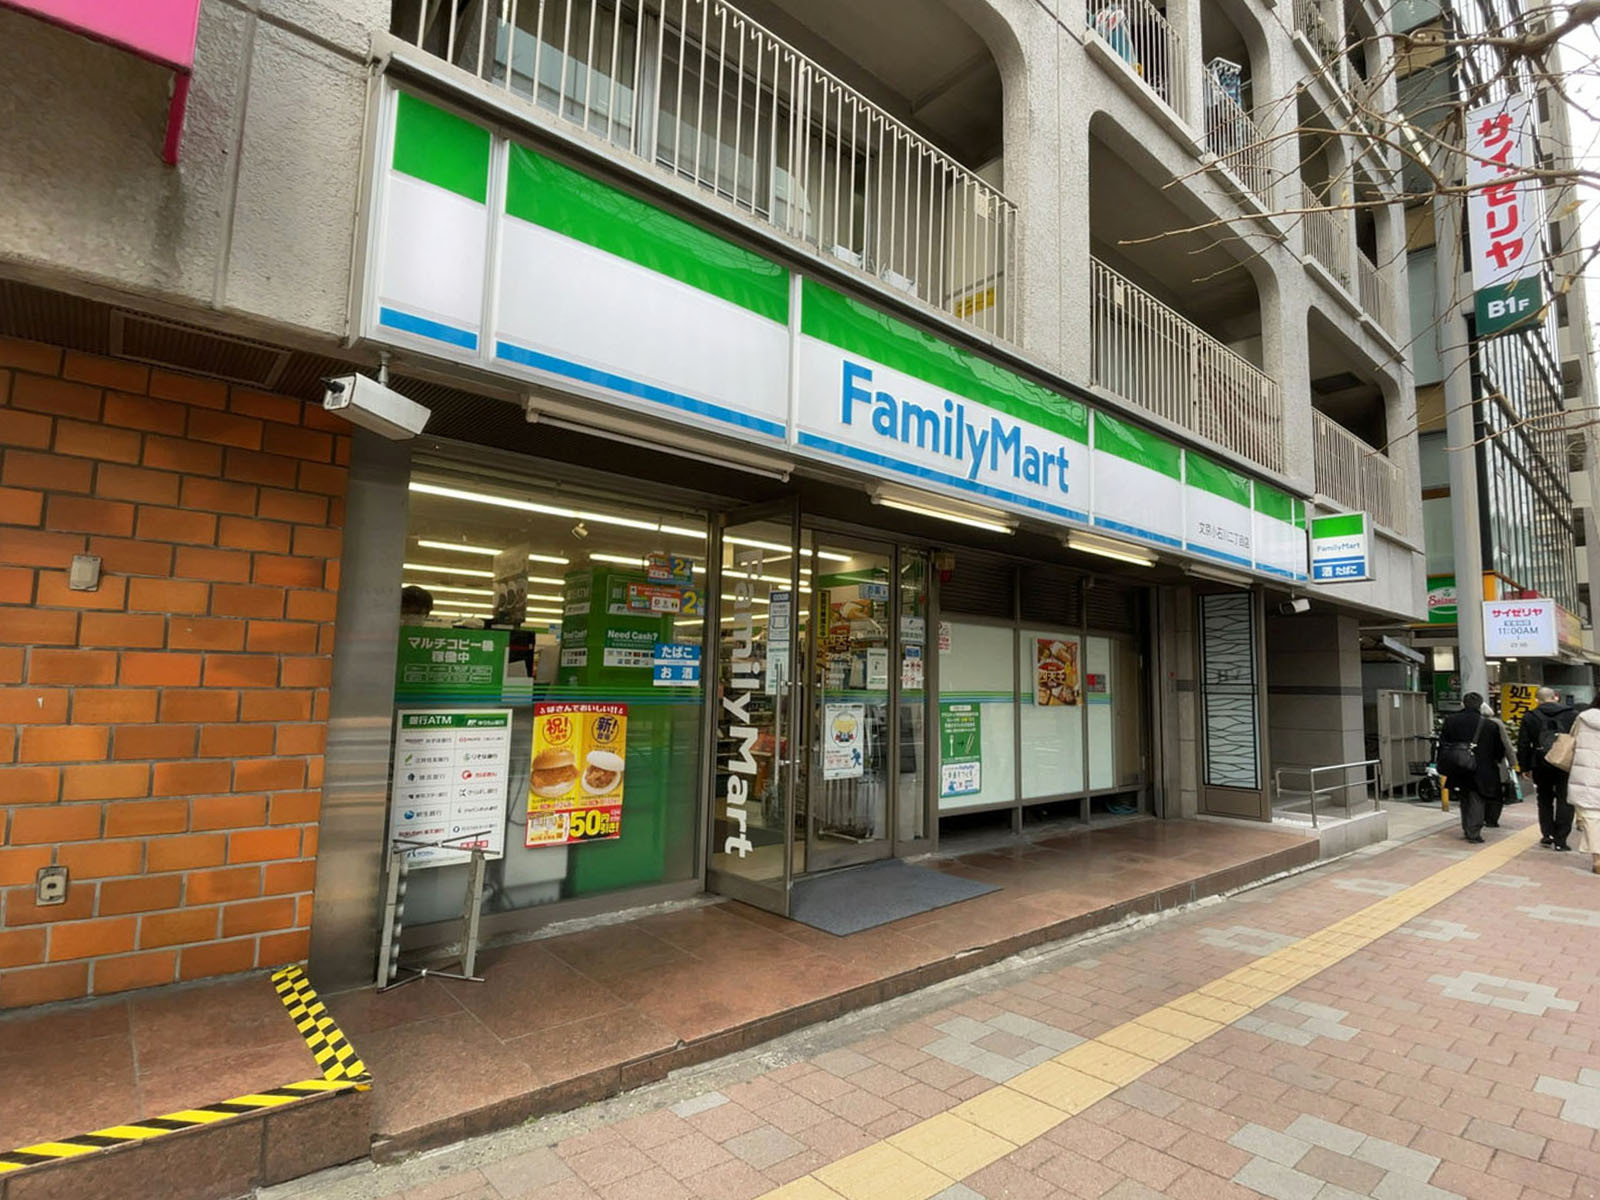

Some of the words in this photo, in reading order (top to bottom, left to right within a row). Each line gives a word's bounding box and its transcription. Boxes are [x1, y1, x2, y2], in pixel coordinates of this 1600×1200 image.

[1476, 113, 1524, 268] サイゼリヤ
[1487, 296, 1531, 319] B1F
[841, 359, 1070, 494] FamilyMart
[1316, 542, 1361, 553] FamilyMart
[1335, 565, 1358, 576] たばこ
[1492, 608, 1542, 618] サイゼリヤ
[607, 630, 630, 640] Need
[631, 631, 659, 642] Cash?
[661, 646, 693, 659] たばこ
[722, 549, 763, 859] FamilyMart
